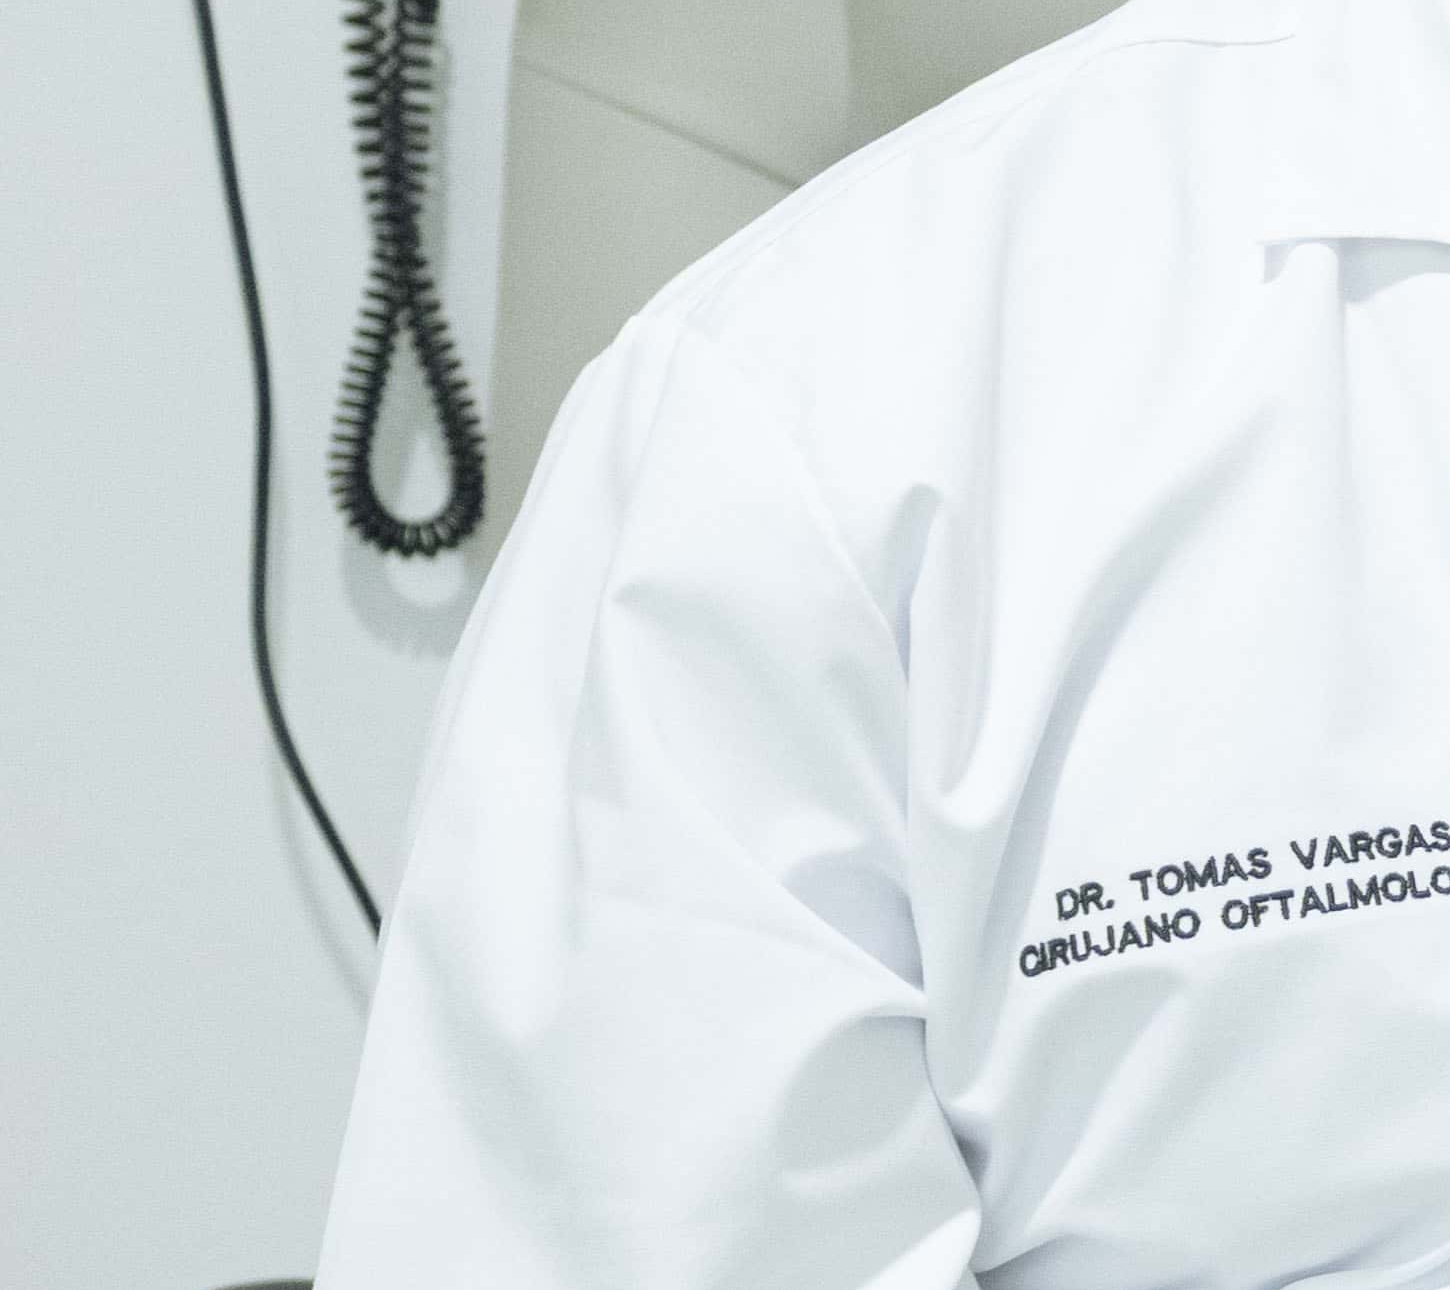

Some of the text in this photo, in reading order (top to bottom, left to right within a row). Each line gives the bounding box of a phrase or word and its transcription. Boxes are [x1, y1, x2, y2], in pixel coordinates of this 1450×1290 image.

[1055, 881, 1115, 922] DR.
[1129, 846, 1273, 902] TOMAS
[1018, 908, 1202, 979] CIRUJANO
